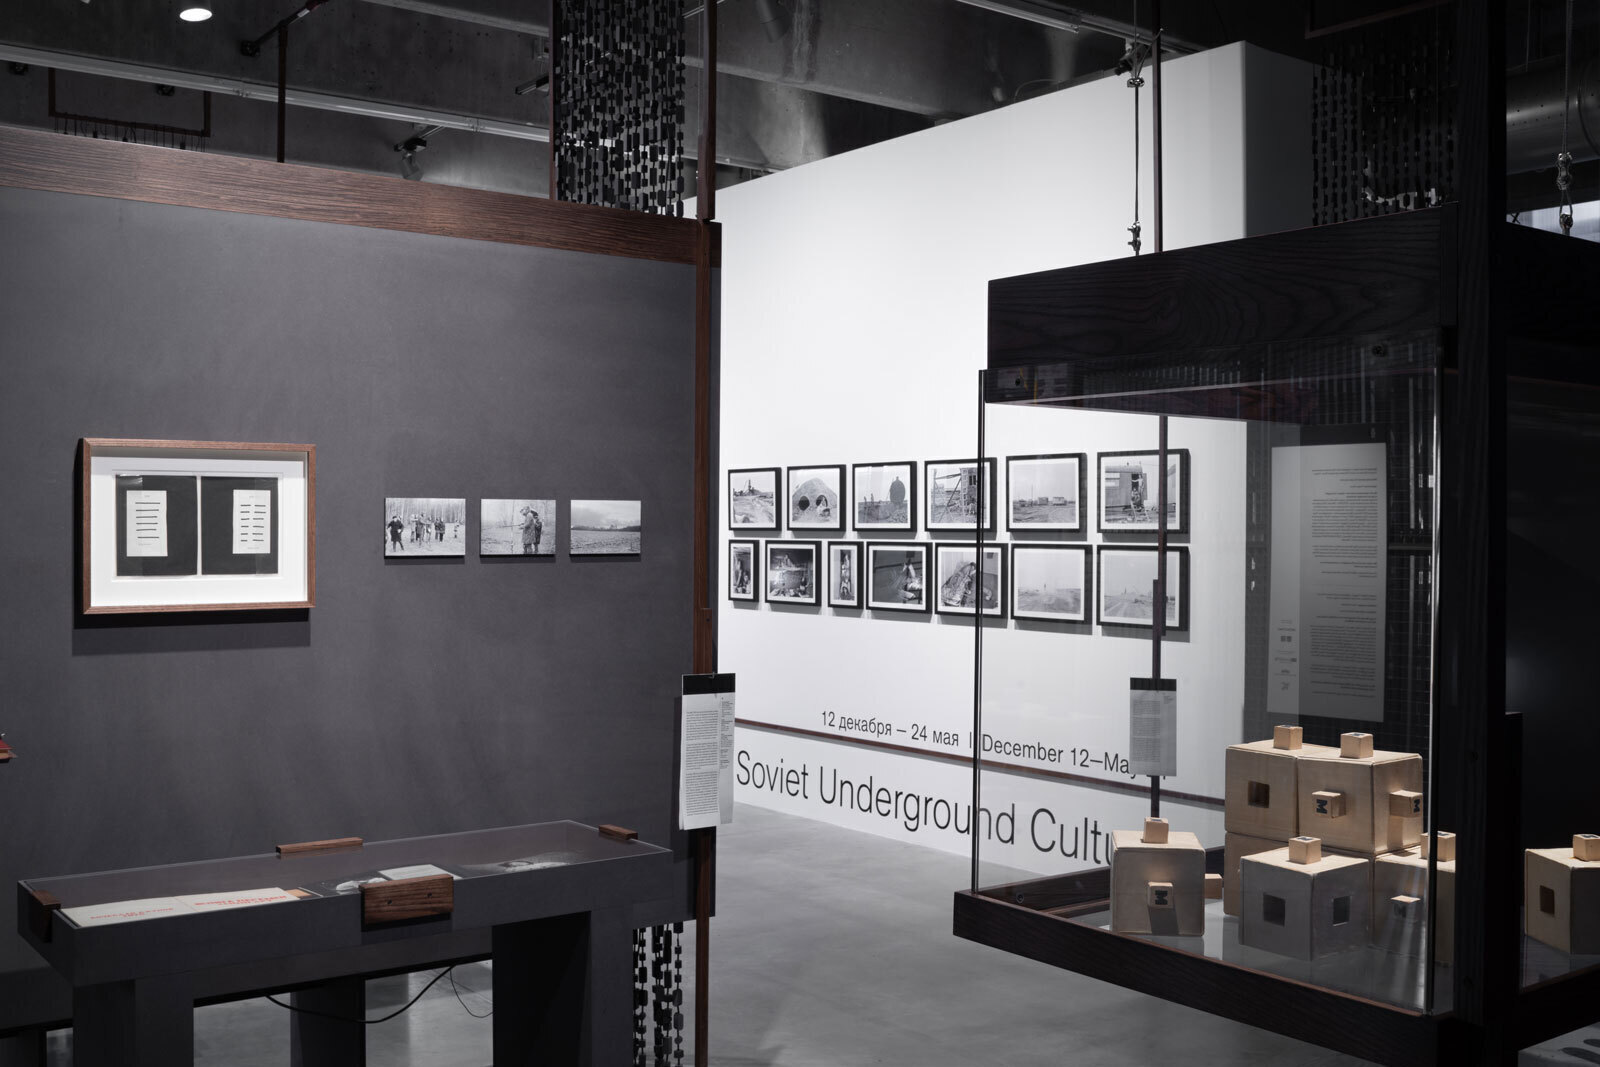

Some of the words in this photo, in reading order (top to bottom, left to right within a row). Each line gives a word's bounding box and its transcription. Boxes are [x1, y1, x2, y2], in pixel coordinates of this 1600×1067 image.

[821, 711, 836, 728] 12
[839, 712, 892, 738] декабря
[911, 723, 928, 741] 24
[932, 730, 959, 747] мая
[982, 733, 1064, 764] December
[736, 750, 809, 800] Soviet
[819, 766, 1015, 845] Underground
